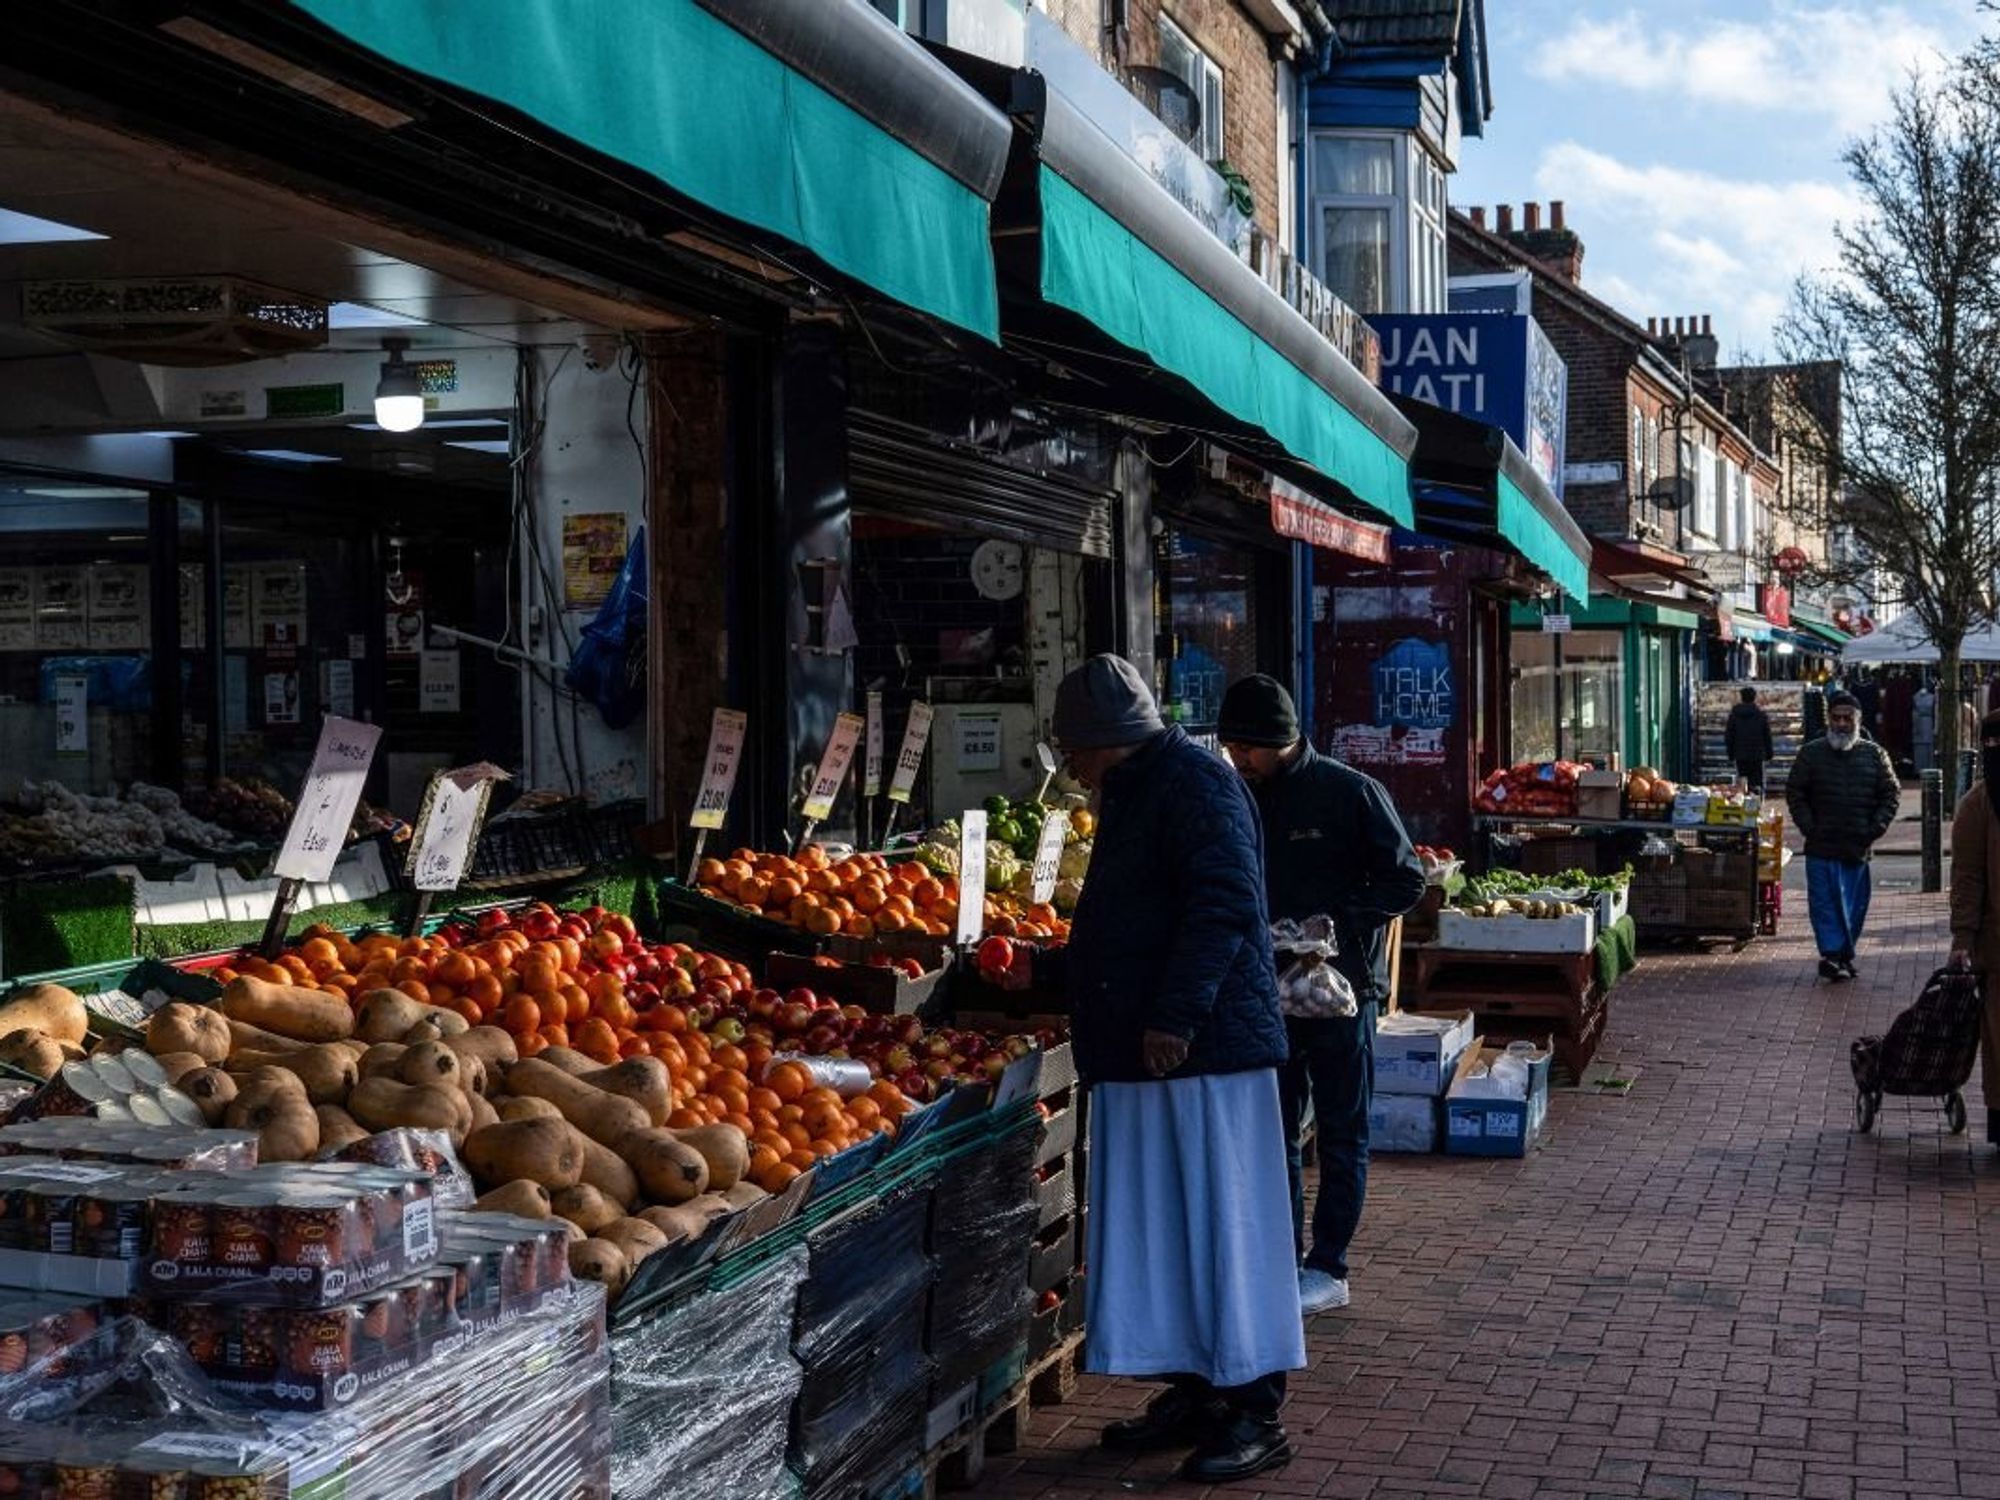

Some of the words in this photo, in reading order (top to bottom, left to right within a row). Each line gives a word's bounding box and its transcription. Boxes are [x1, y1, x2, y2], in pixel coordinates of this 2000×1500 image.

[1380, 667, 1451, 693] TALK
[1379, 693, 1452, 719] HOME
[310, 1353, 345, 1367] CHANA
[314, 1344, 341, 1356] KALA
